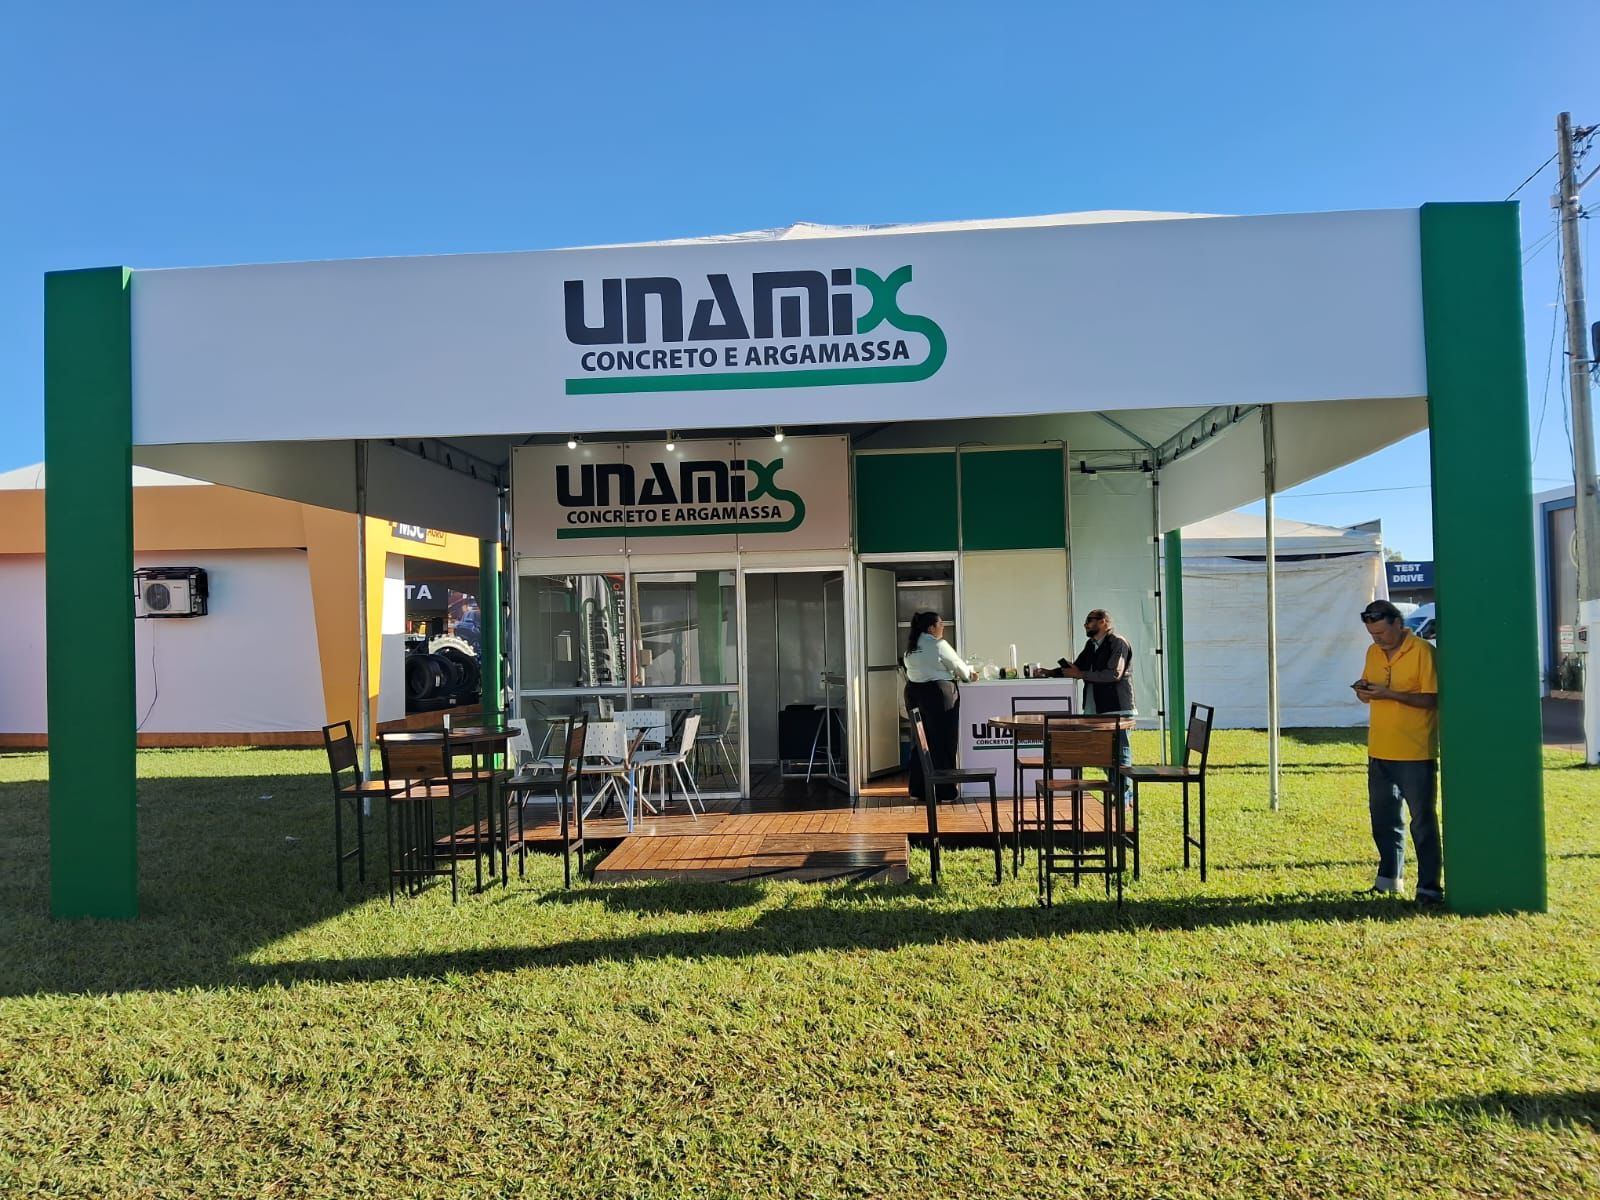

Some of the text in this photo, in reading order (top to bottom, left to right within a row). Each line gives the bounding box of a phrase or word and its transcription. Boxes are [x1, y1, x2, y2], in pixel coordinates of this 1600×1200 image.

[580, 339, 911, 372] CONCRETO E ARGAMASSA
[566, 505, 782, 524] CONCRETO E ARGAMASSA
[1393, 563, 1421, 572] TEST
[1392, 573, 1425, 583] DRIVE
